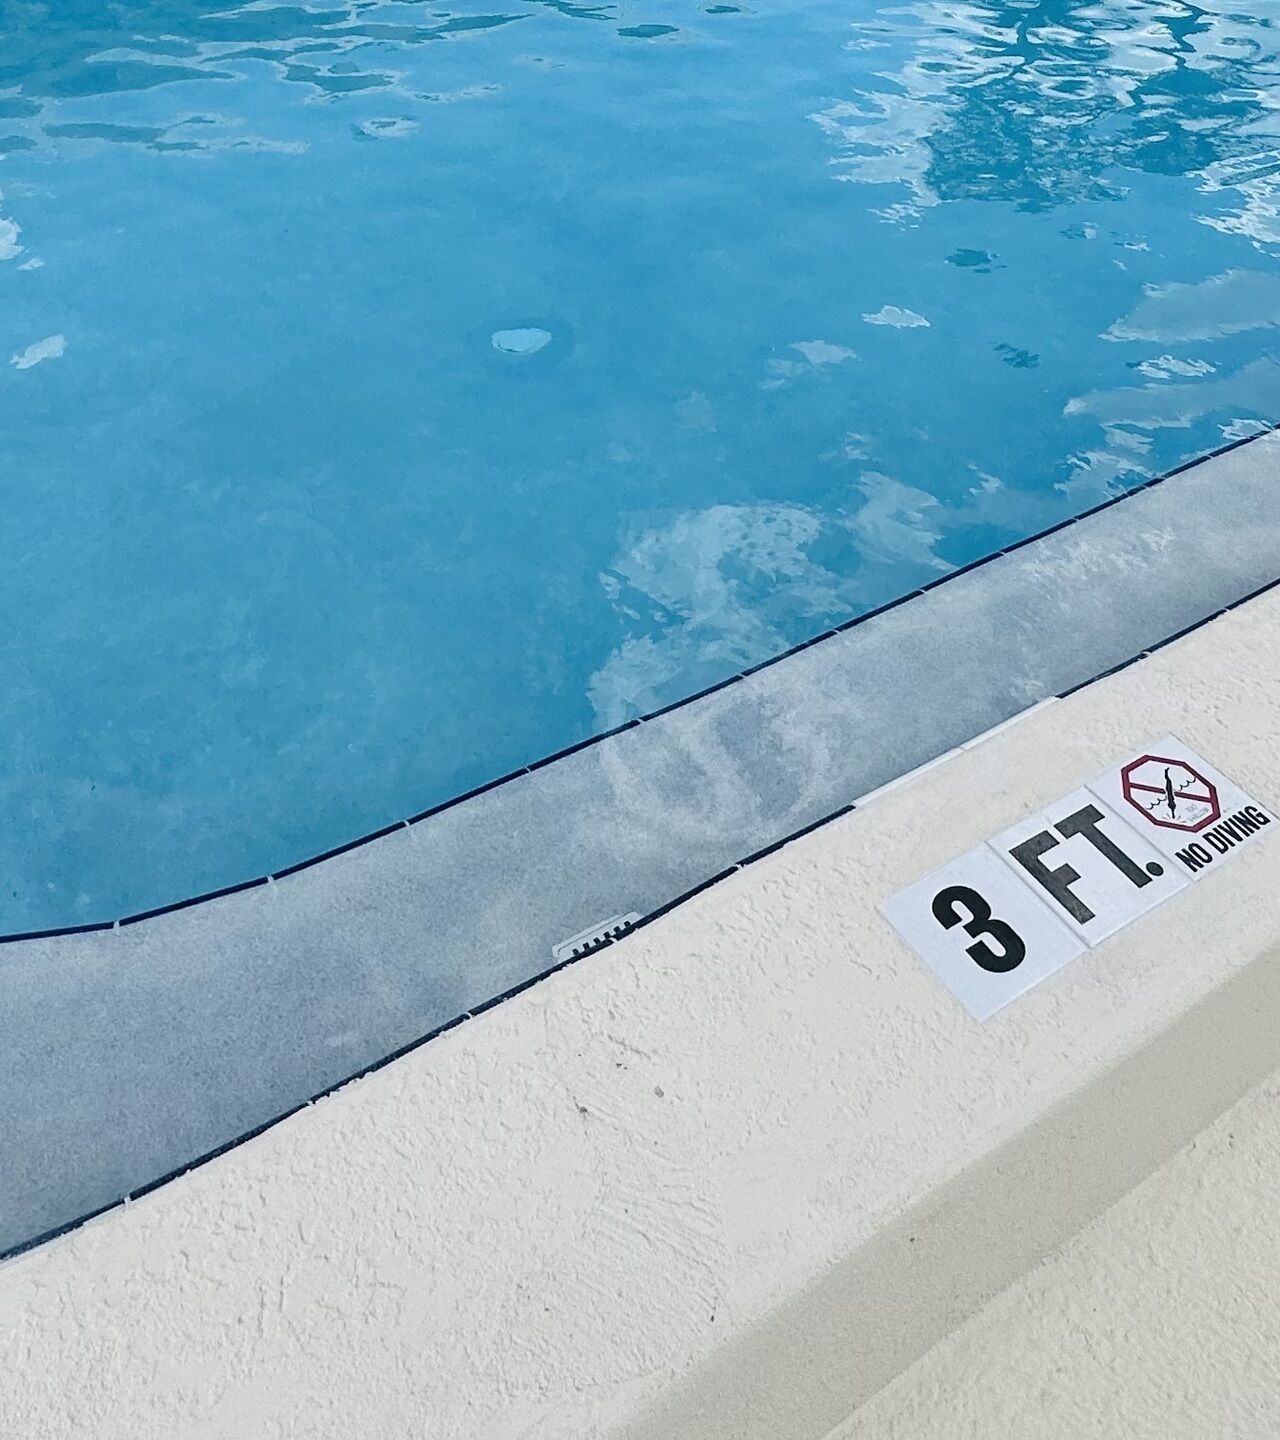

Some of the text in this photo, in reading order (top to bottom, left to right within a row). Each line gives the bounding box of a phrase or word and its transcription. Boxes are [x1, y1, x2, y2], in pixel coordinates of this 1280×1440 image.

[932, 803, 1165, 973] 3 FT.
[1175, 805, 1271, 873] NO DIVING
